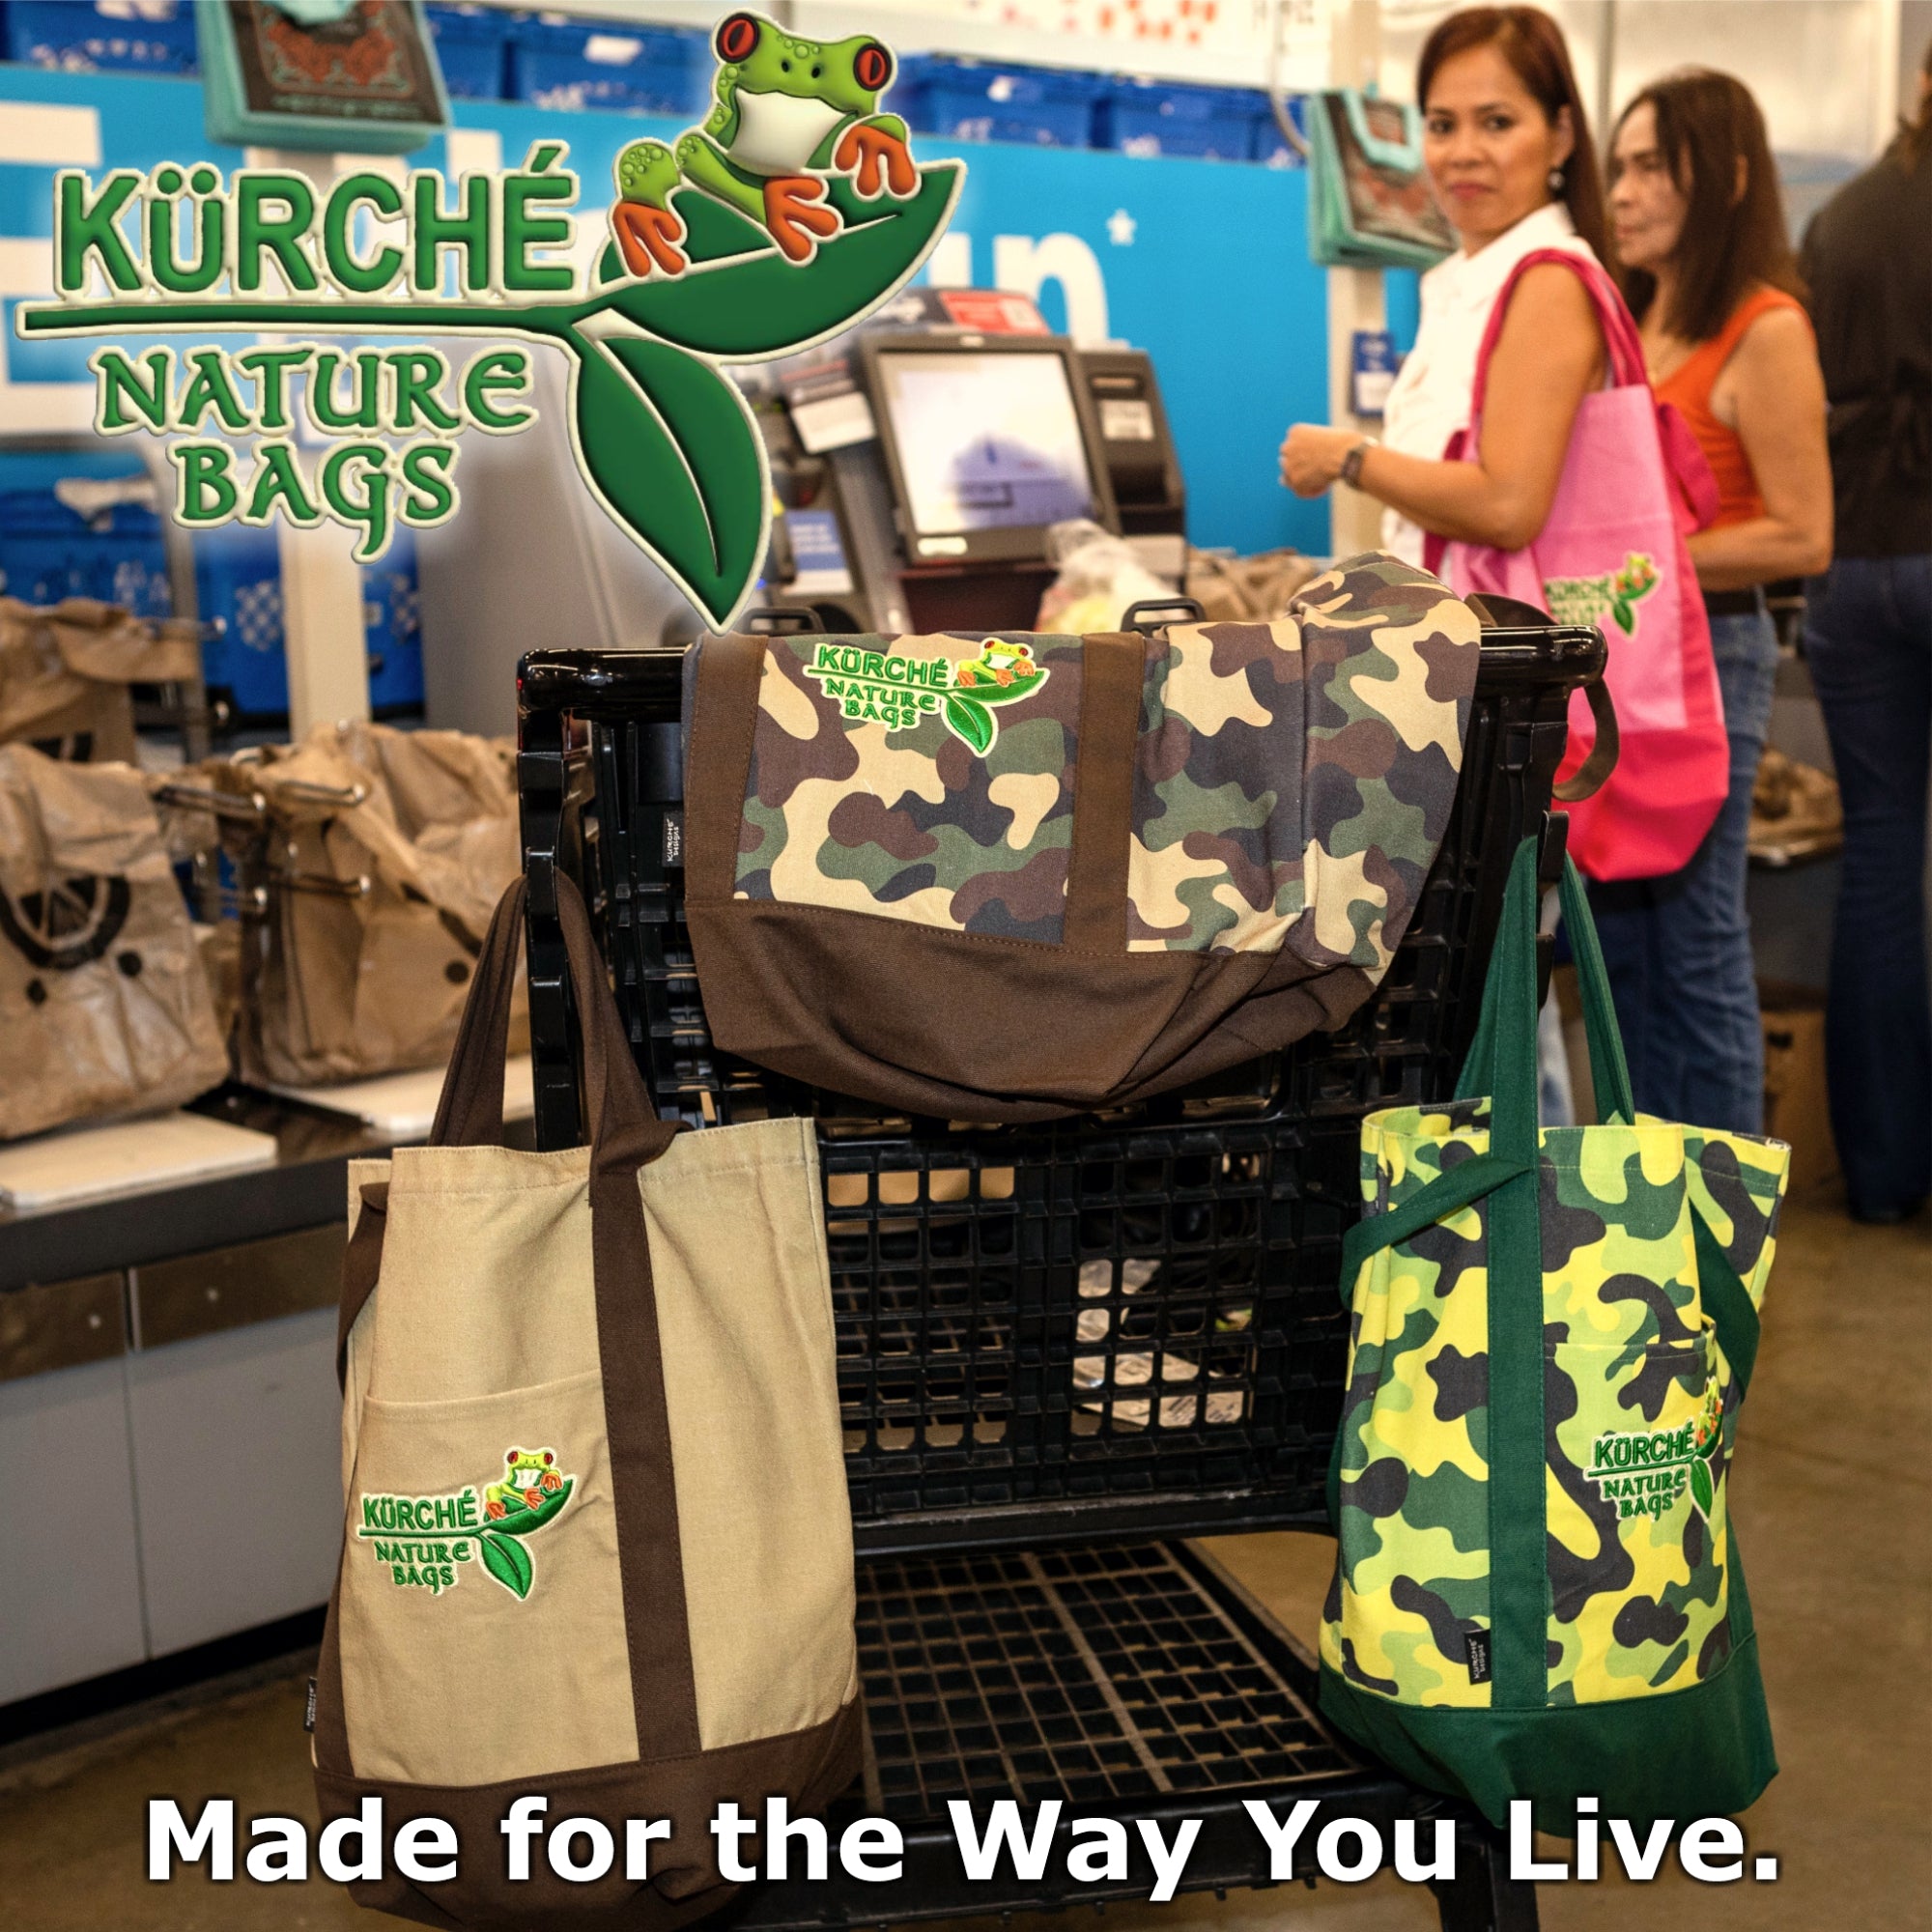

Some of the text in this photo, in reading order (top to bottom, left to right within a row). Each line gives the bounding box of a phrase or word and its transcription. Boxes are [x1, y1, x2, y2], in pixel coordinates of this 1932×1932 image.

[818, 645, 949, 688] KÜRCHÉ
[826, 678, 937, 711] NATURE
[844, 699, 917, 729] BAGS
[1595, 1421, 1695, 1468] KÜRCHÉ
[1604, 1468, 1686, 1499] NATURE
[363, 1489, 479, 1530] KÜRCHÉ
[1619, 1492, 1674, 1521] BAGS
[374, 1540, 472, 1564] NATURE
[391, 1565, 455, 1595] BAGS
